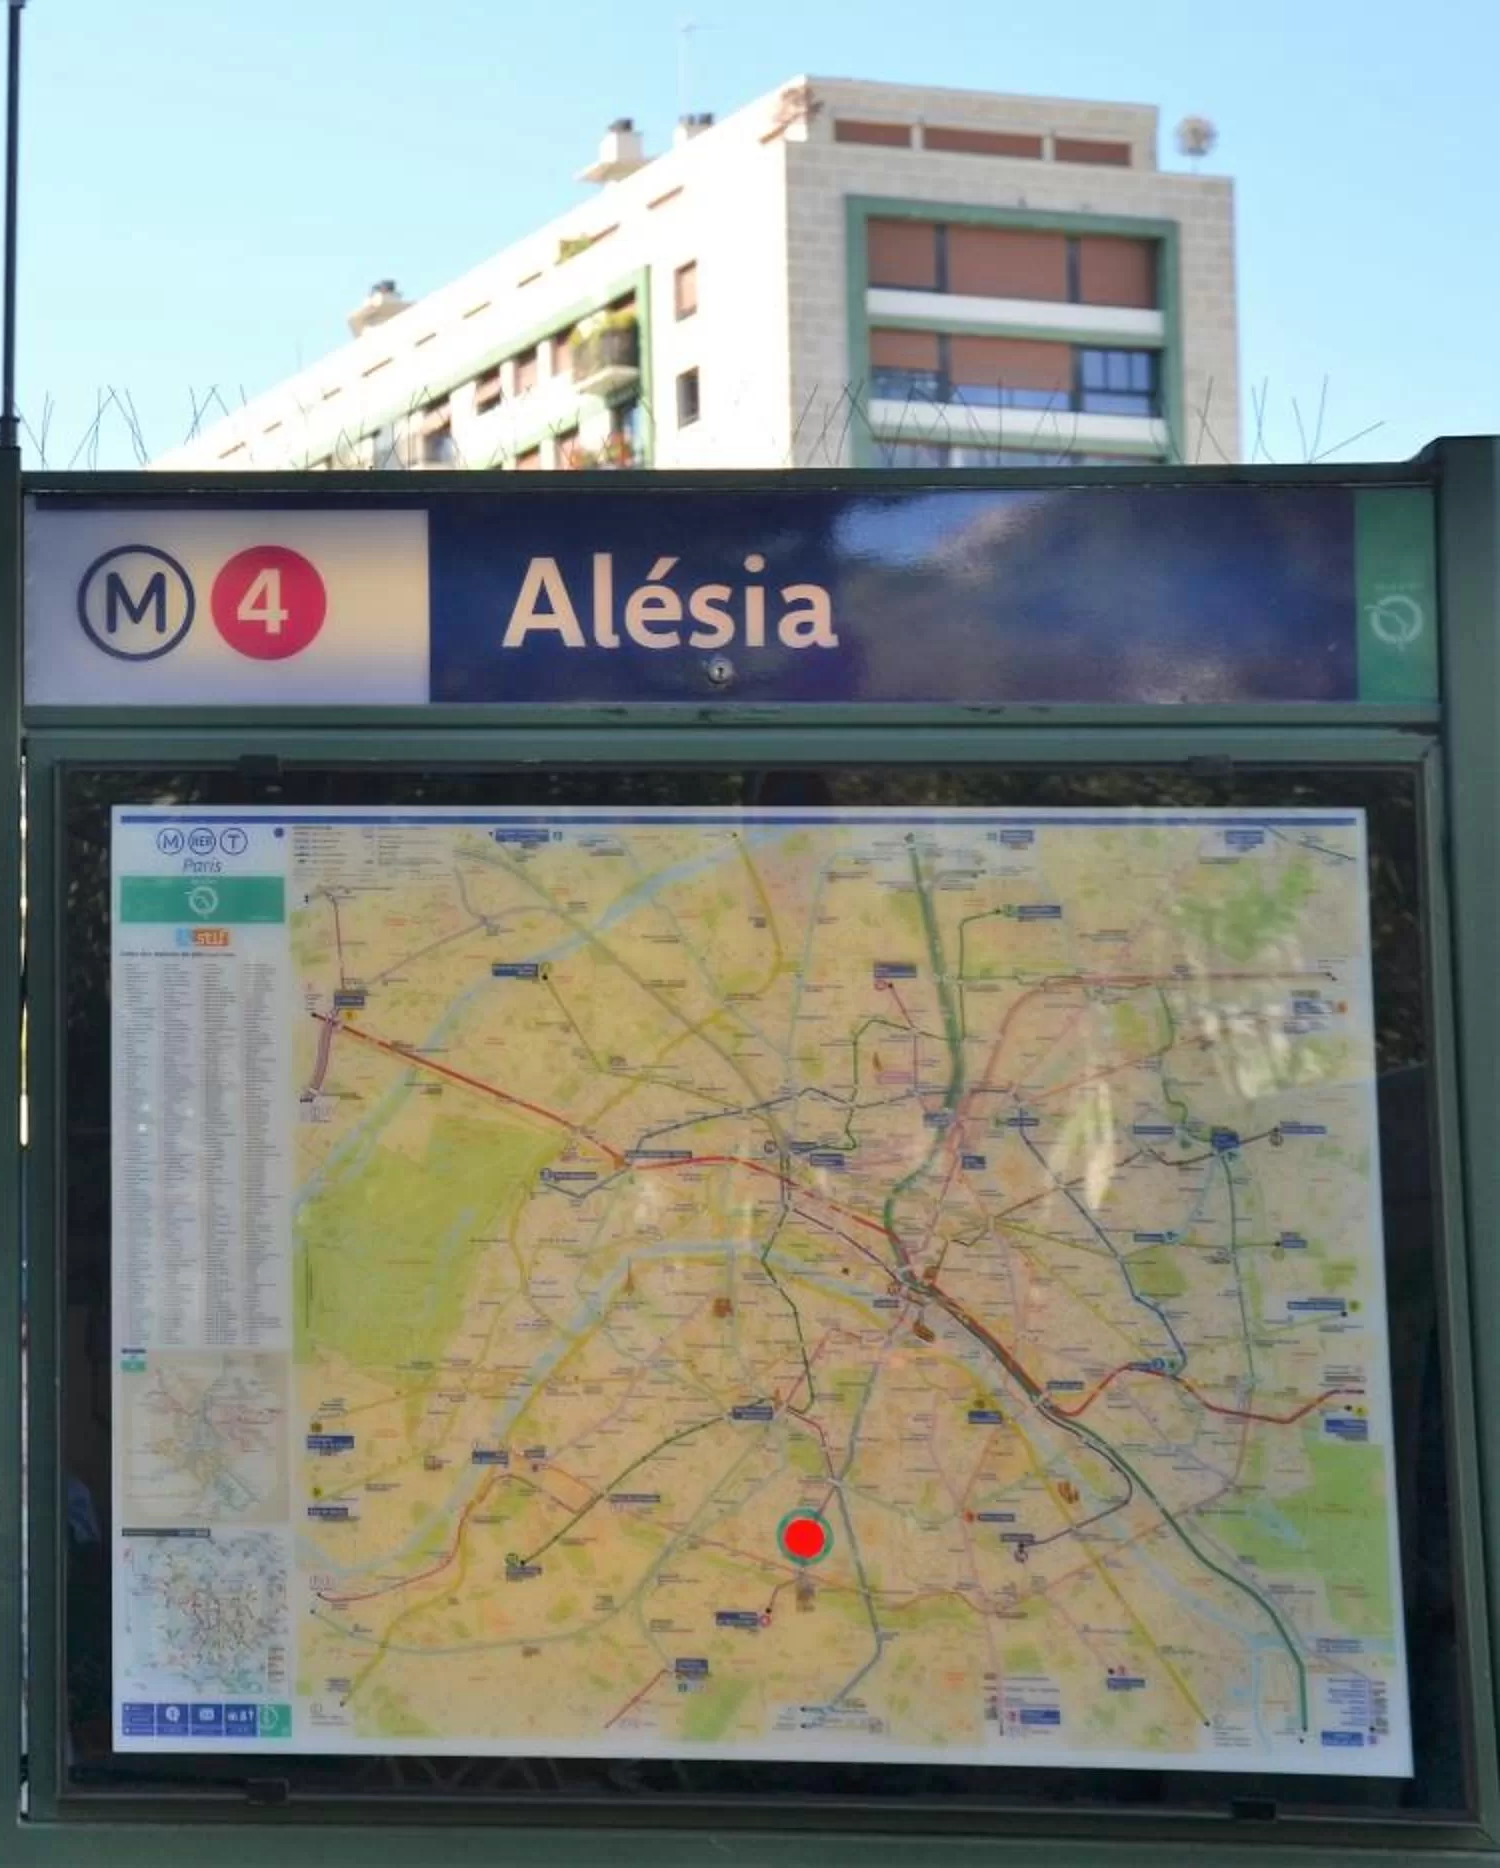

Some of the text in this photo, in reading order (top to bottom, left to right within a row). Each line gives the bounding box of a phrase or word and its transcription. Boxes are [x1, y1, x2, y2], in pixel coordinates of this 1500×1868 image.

[236, 567, 290, 635] 4
[502, 552, 840, 650] Alésia
[183, 858, 223, 873] Paris
